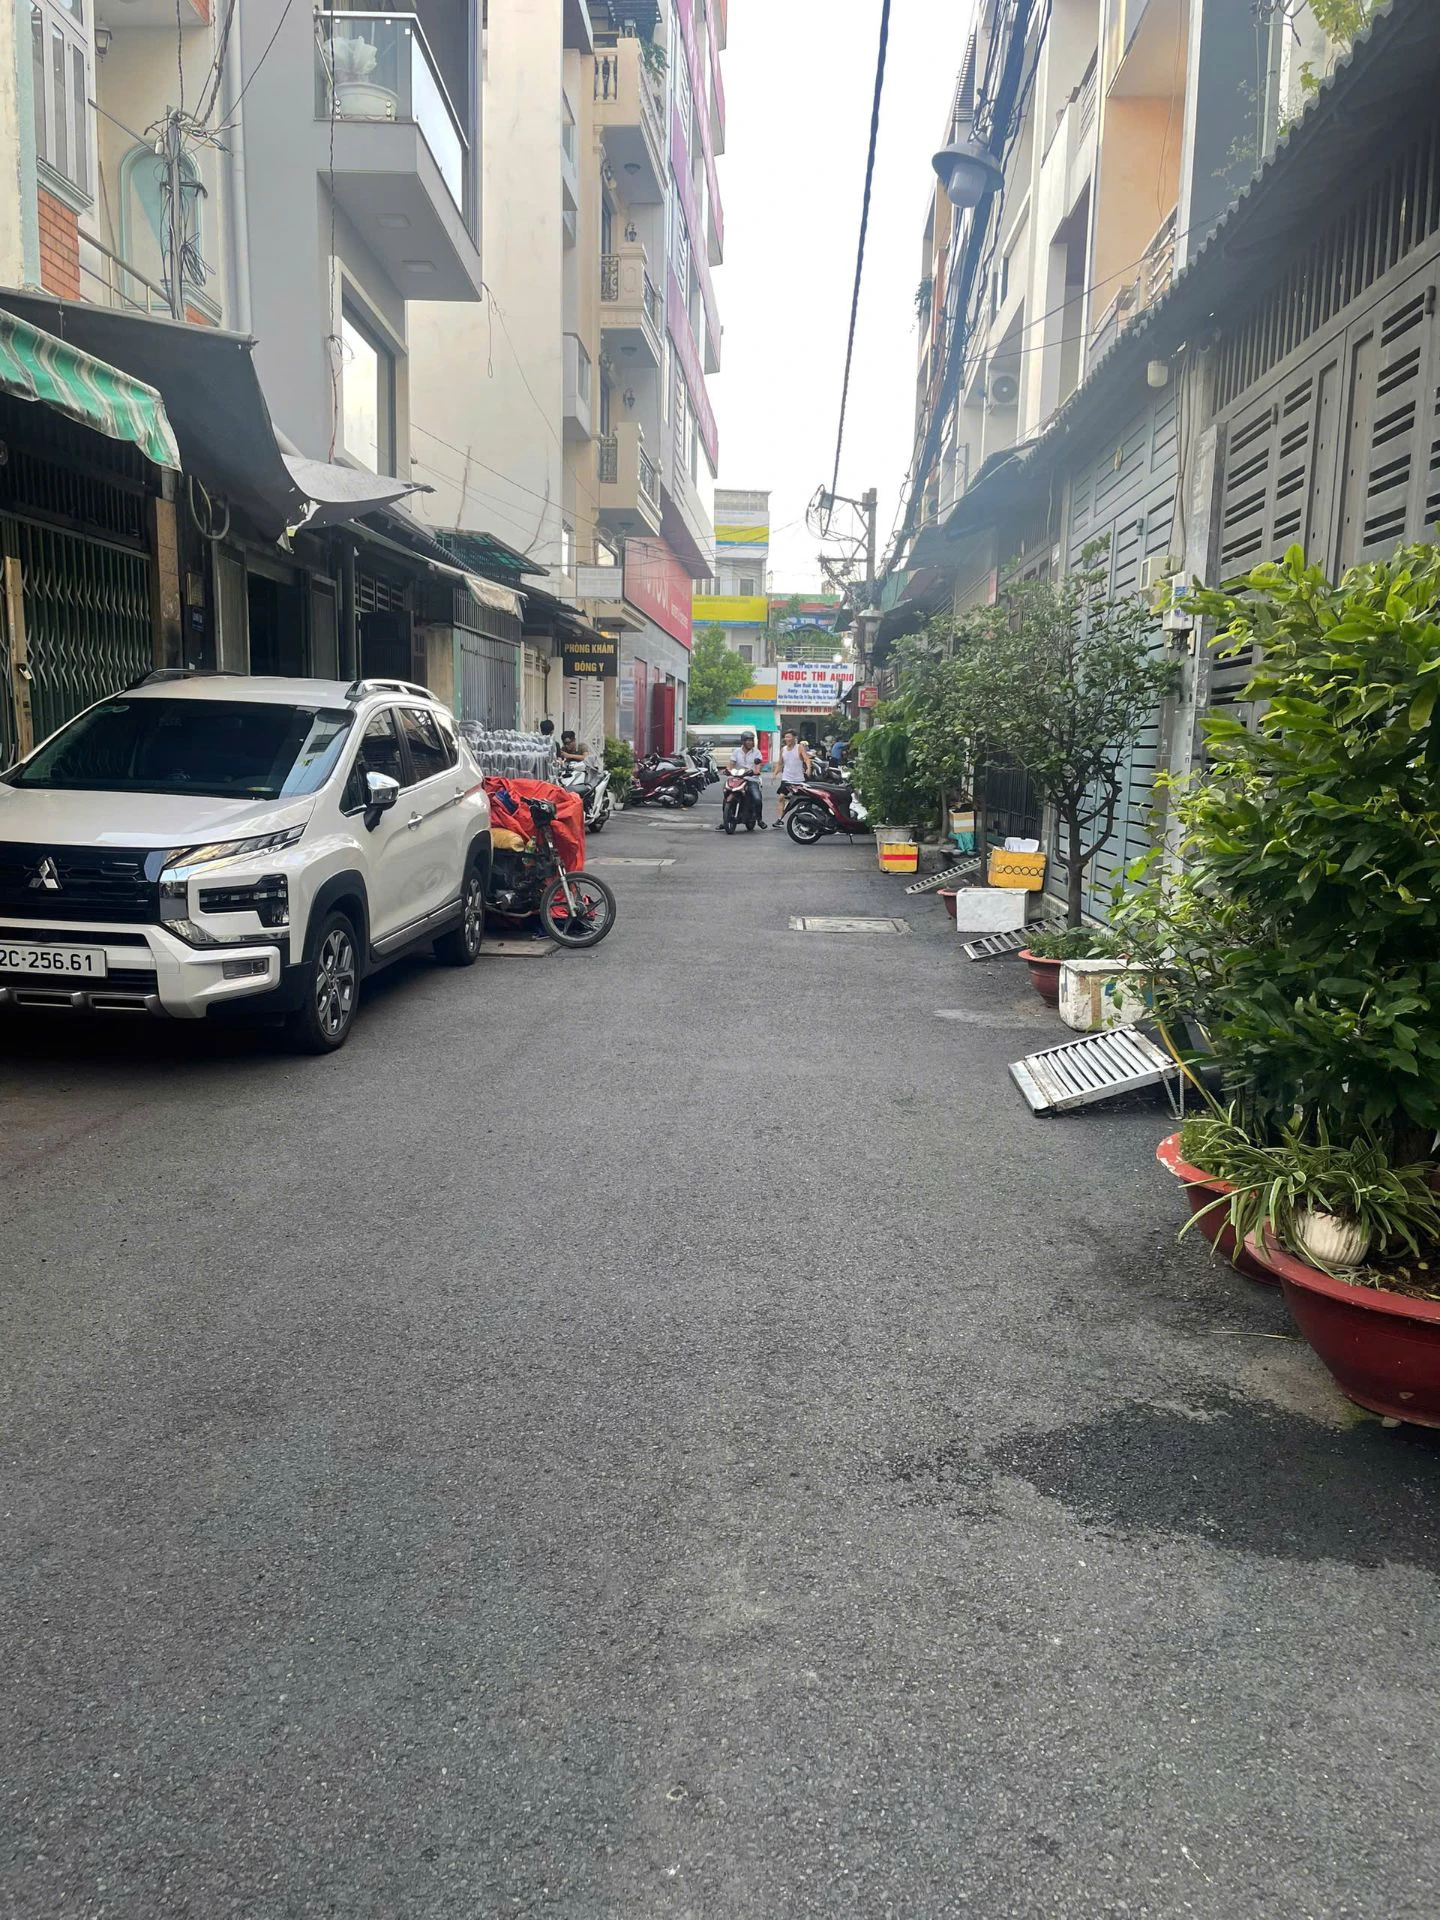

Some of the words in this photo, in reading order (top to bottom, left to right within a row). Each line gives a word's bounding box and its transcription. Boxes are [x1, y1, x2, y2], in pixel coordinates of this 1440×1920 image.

[565, 642, 590, 654] PHÒNG
[591, 642, 614, 654] KHÁM
[598, 662, 605, 672] Y
[811, 671, 826, 681] THI
